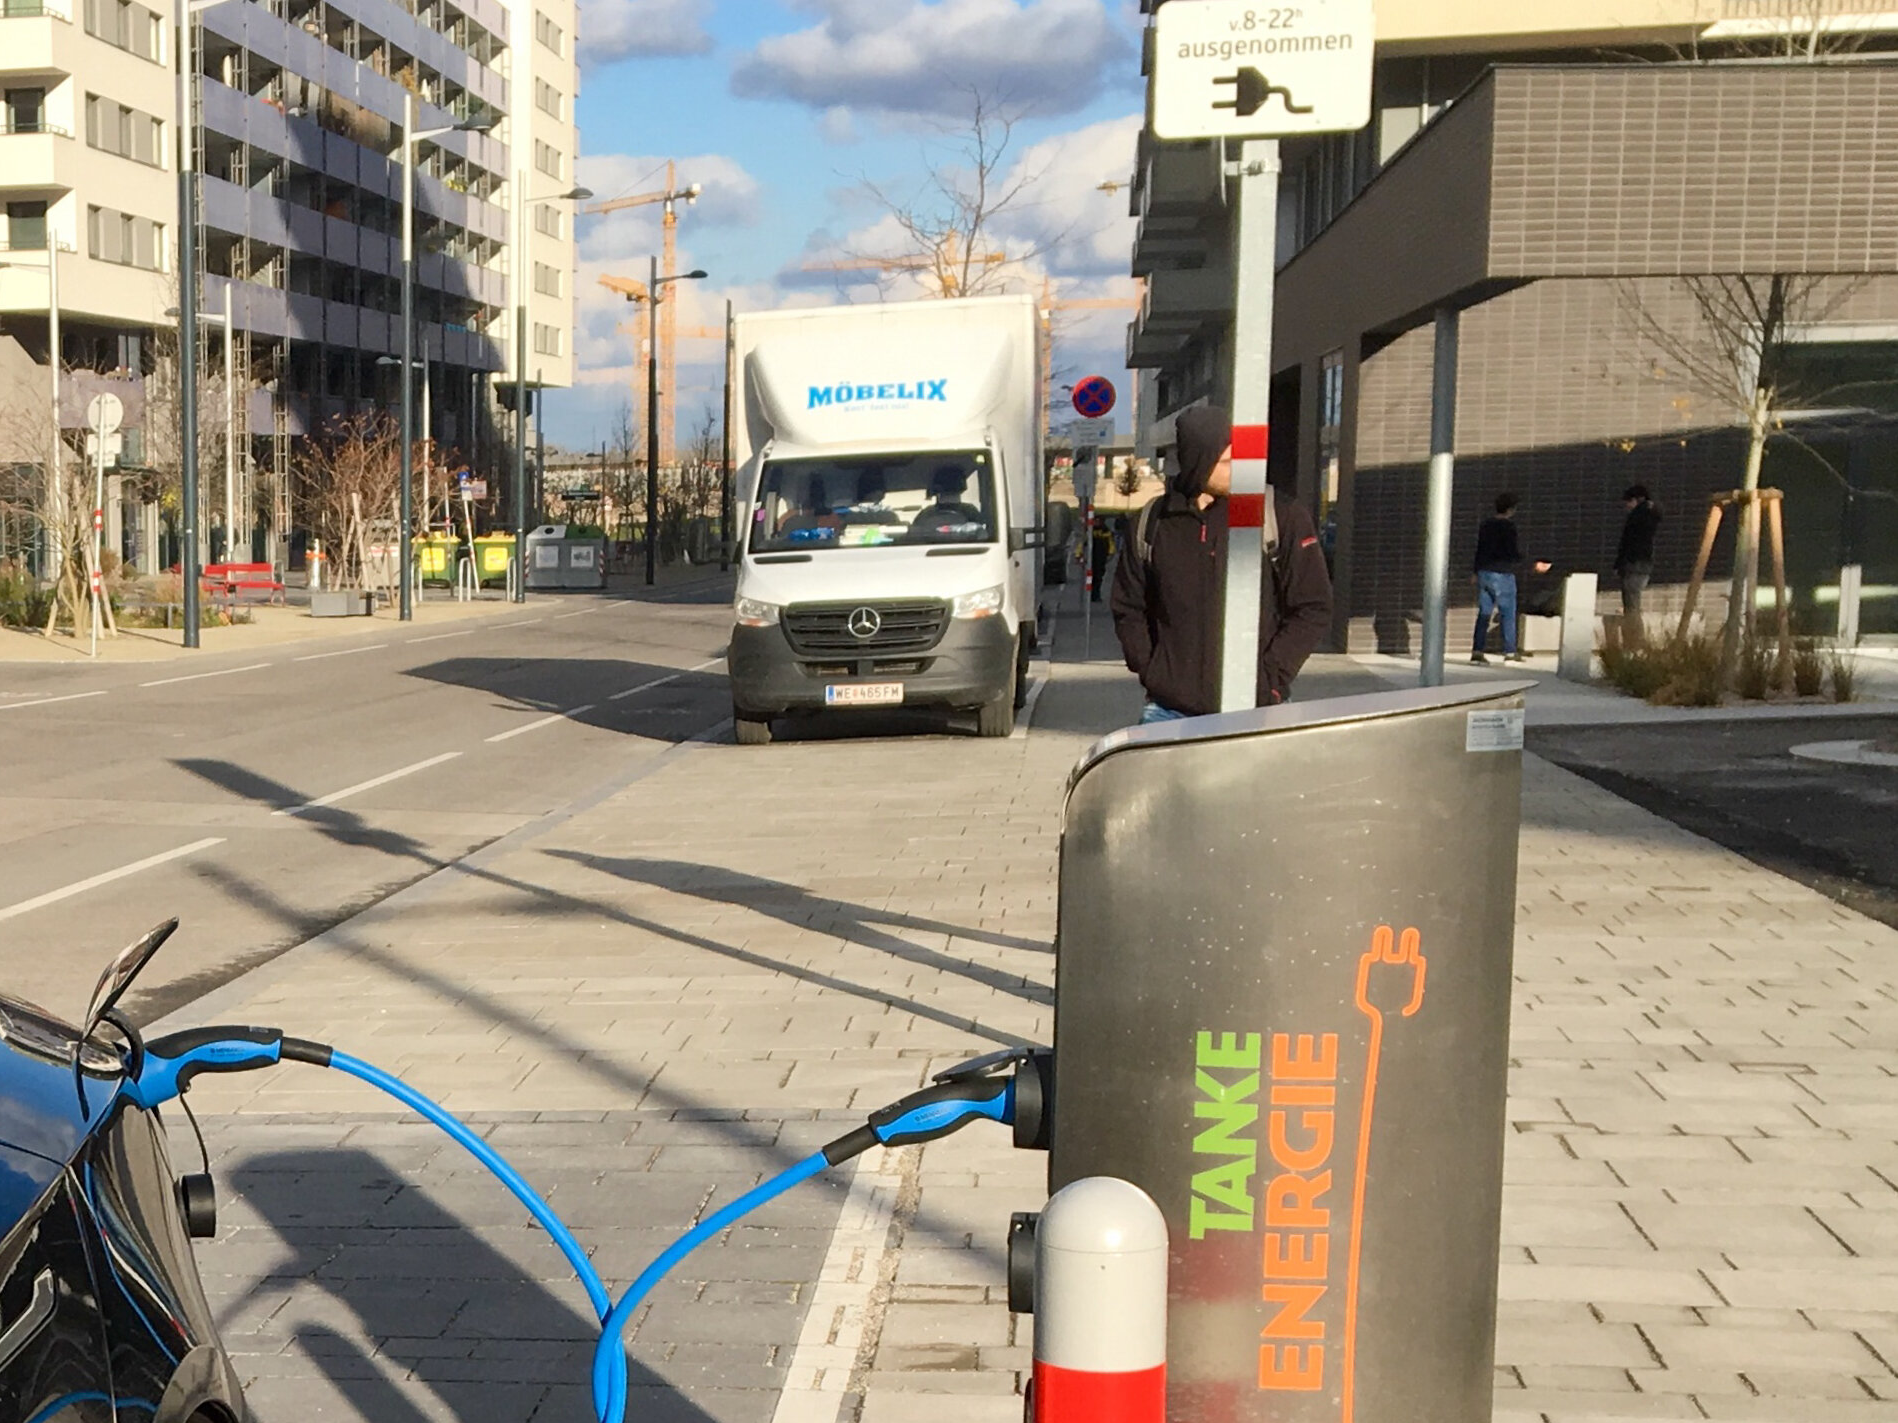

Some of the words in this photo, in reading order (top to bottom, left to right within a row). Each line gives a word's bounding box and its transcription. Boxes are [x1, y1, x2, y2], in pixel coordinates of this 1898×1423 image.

[1178, 33, 1352, 61] ausgenommen
[807, 378, 948, 410] MÖBELIX
[1189, 1030, 1261, 1240] TANKE
[1259, 1033, 1338, 1391] ENERGIE
